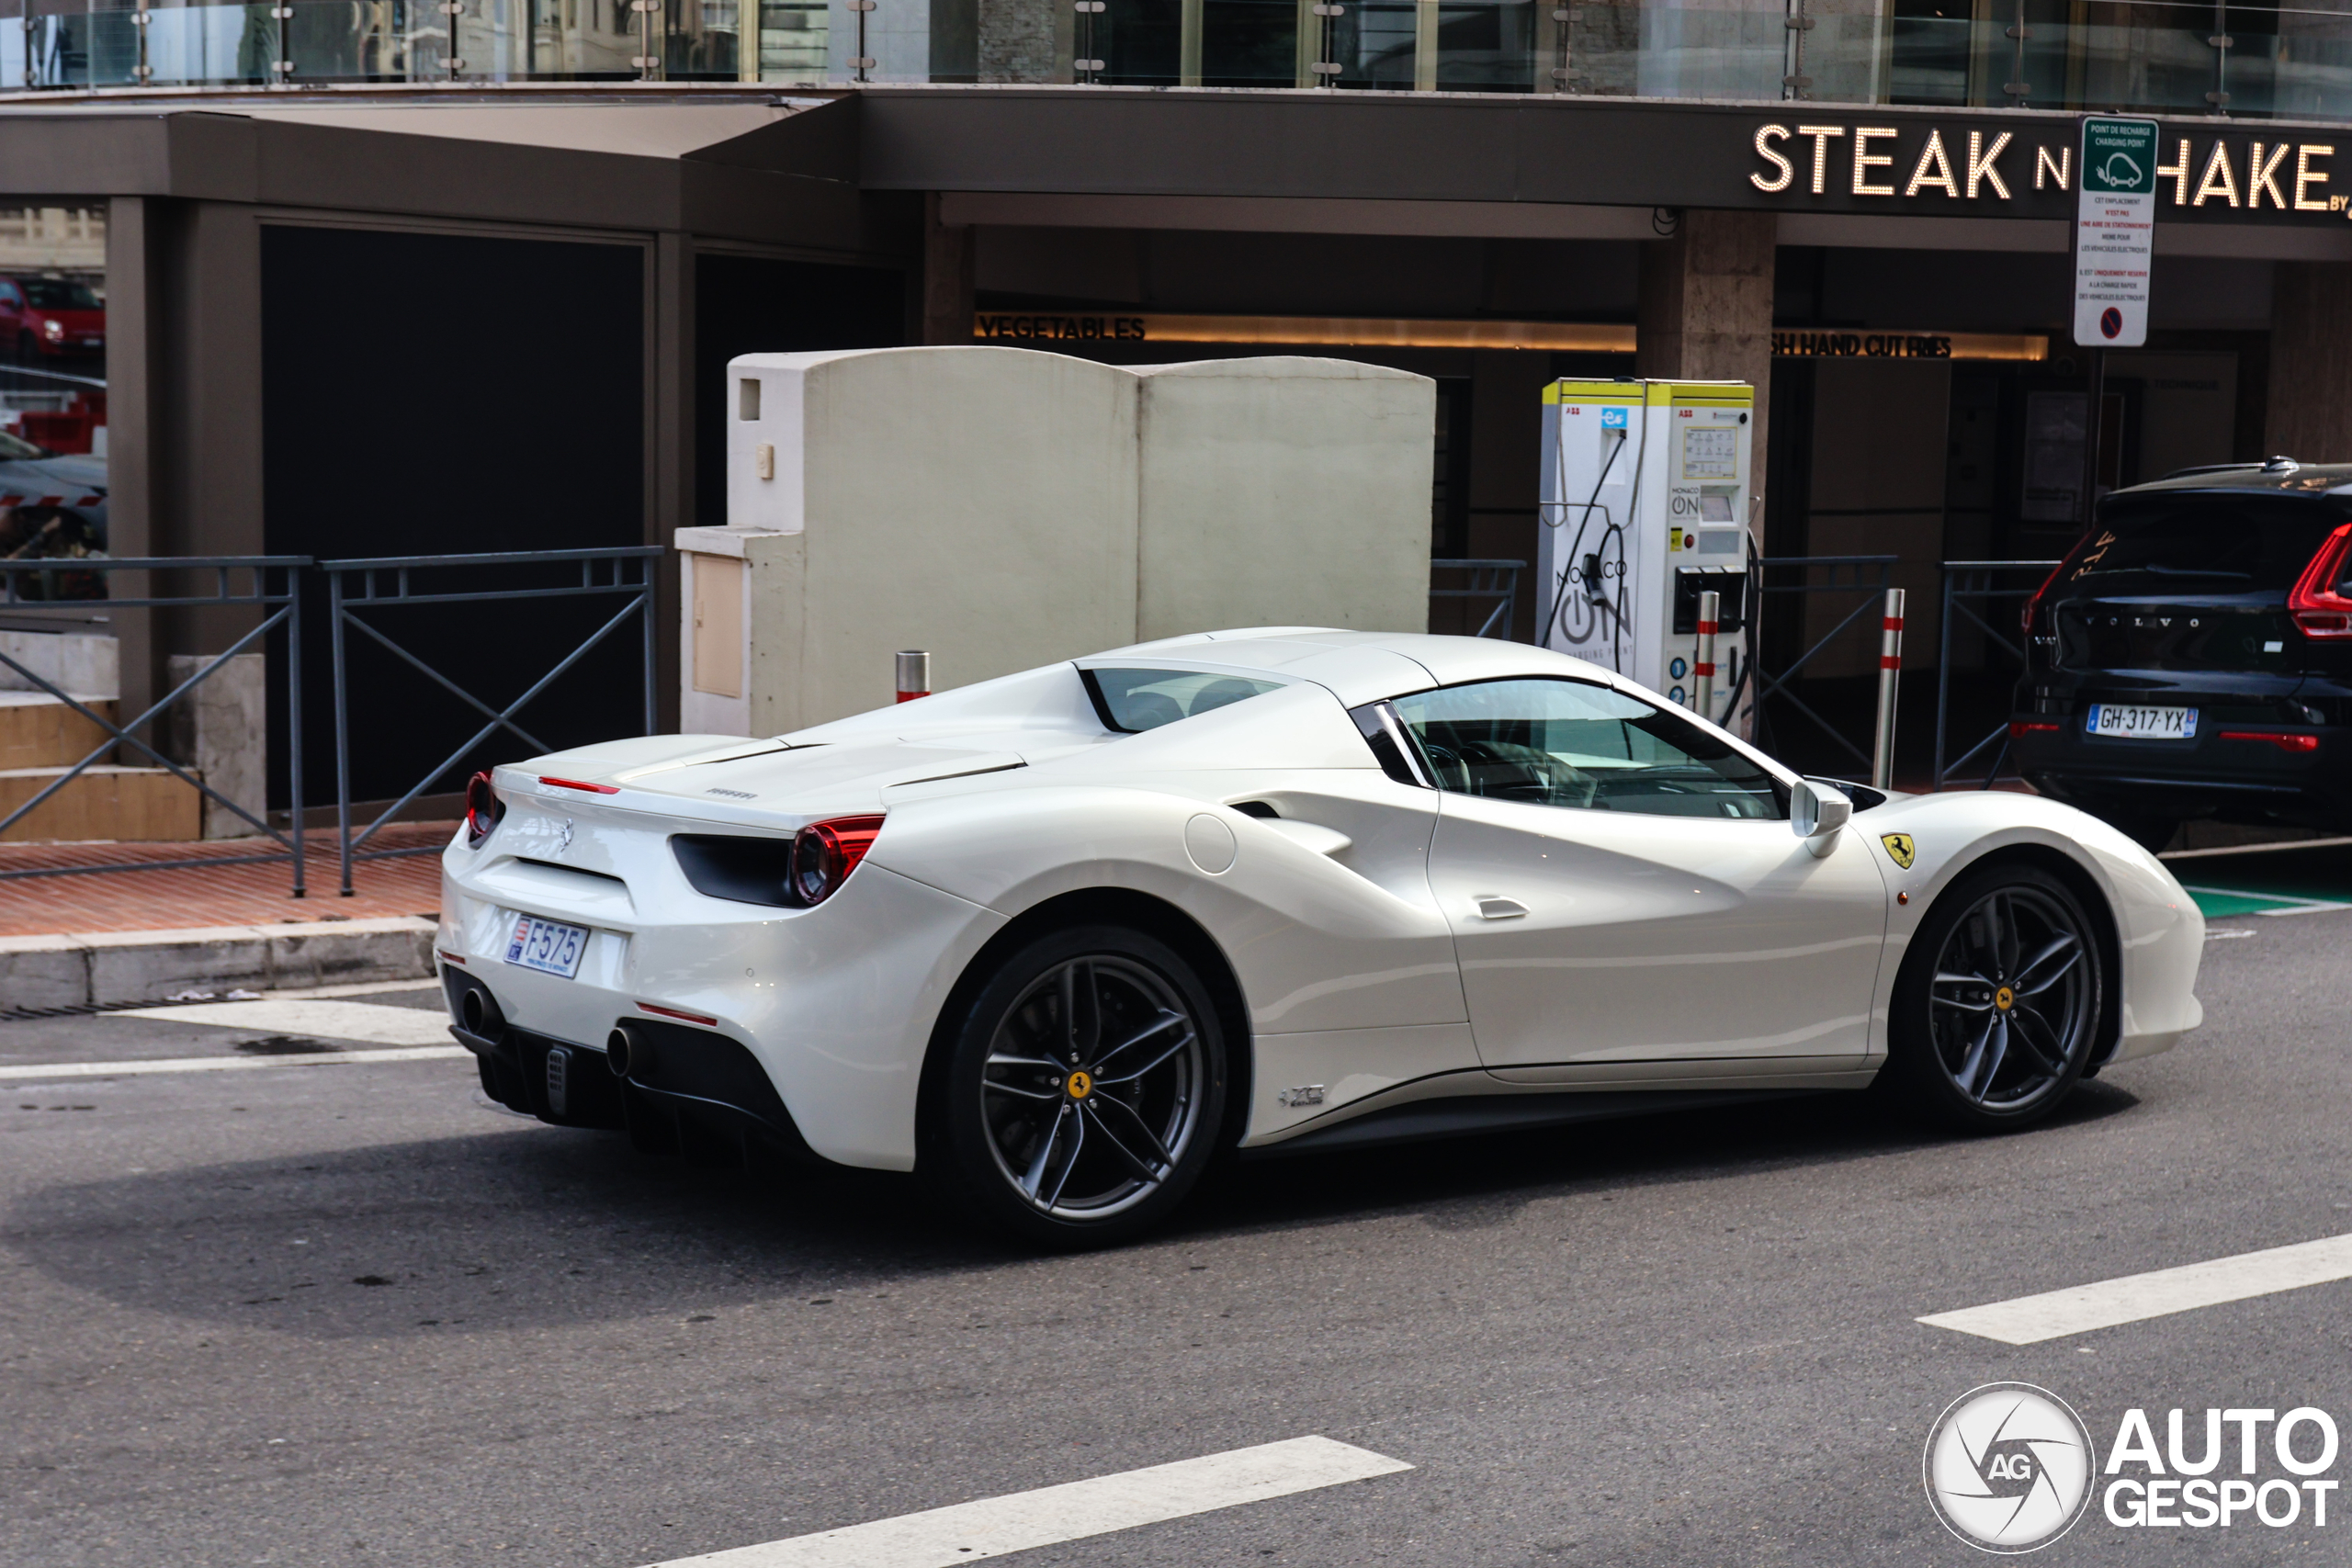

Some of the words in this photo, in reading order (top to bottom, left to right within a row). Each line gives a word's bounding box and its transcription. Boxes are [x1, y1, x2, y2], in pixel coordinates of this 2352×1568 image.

[2091, 125, 2109, 134] POINT
[2110, 126, 2119, 134] DE
[2120, 126, 2151, 136] RECHARGE
[2096, 138, 2127, 147] CHARGING
[2127, 139, 2145, 148] POINT
[1747, 123, 2014, 200] STEAK
[2157, 139, 2335, 210] HAKE
[2330, 195, 2349, 211] BY
[980, 316, 1145, 340] VEGETABLES
[1800, 333, 1860, 356] HAND
[1864, 334, 1905, 356] CUT
[1906, 336, 1951, 358] FRIES
[1566, 407, 1580, 415] ABB
[1679, 410, 1693, 418] ABB
[1556, 559, 1627, 586] MOCO
[2086, 617, 2199, 627] VOLVO
[1608, 645, 1633, 657] PINT
[526, 921, 579, 965] F575
